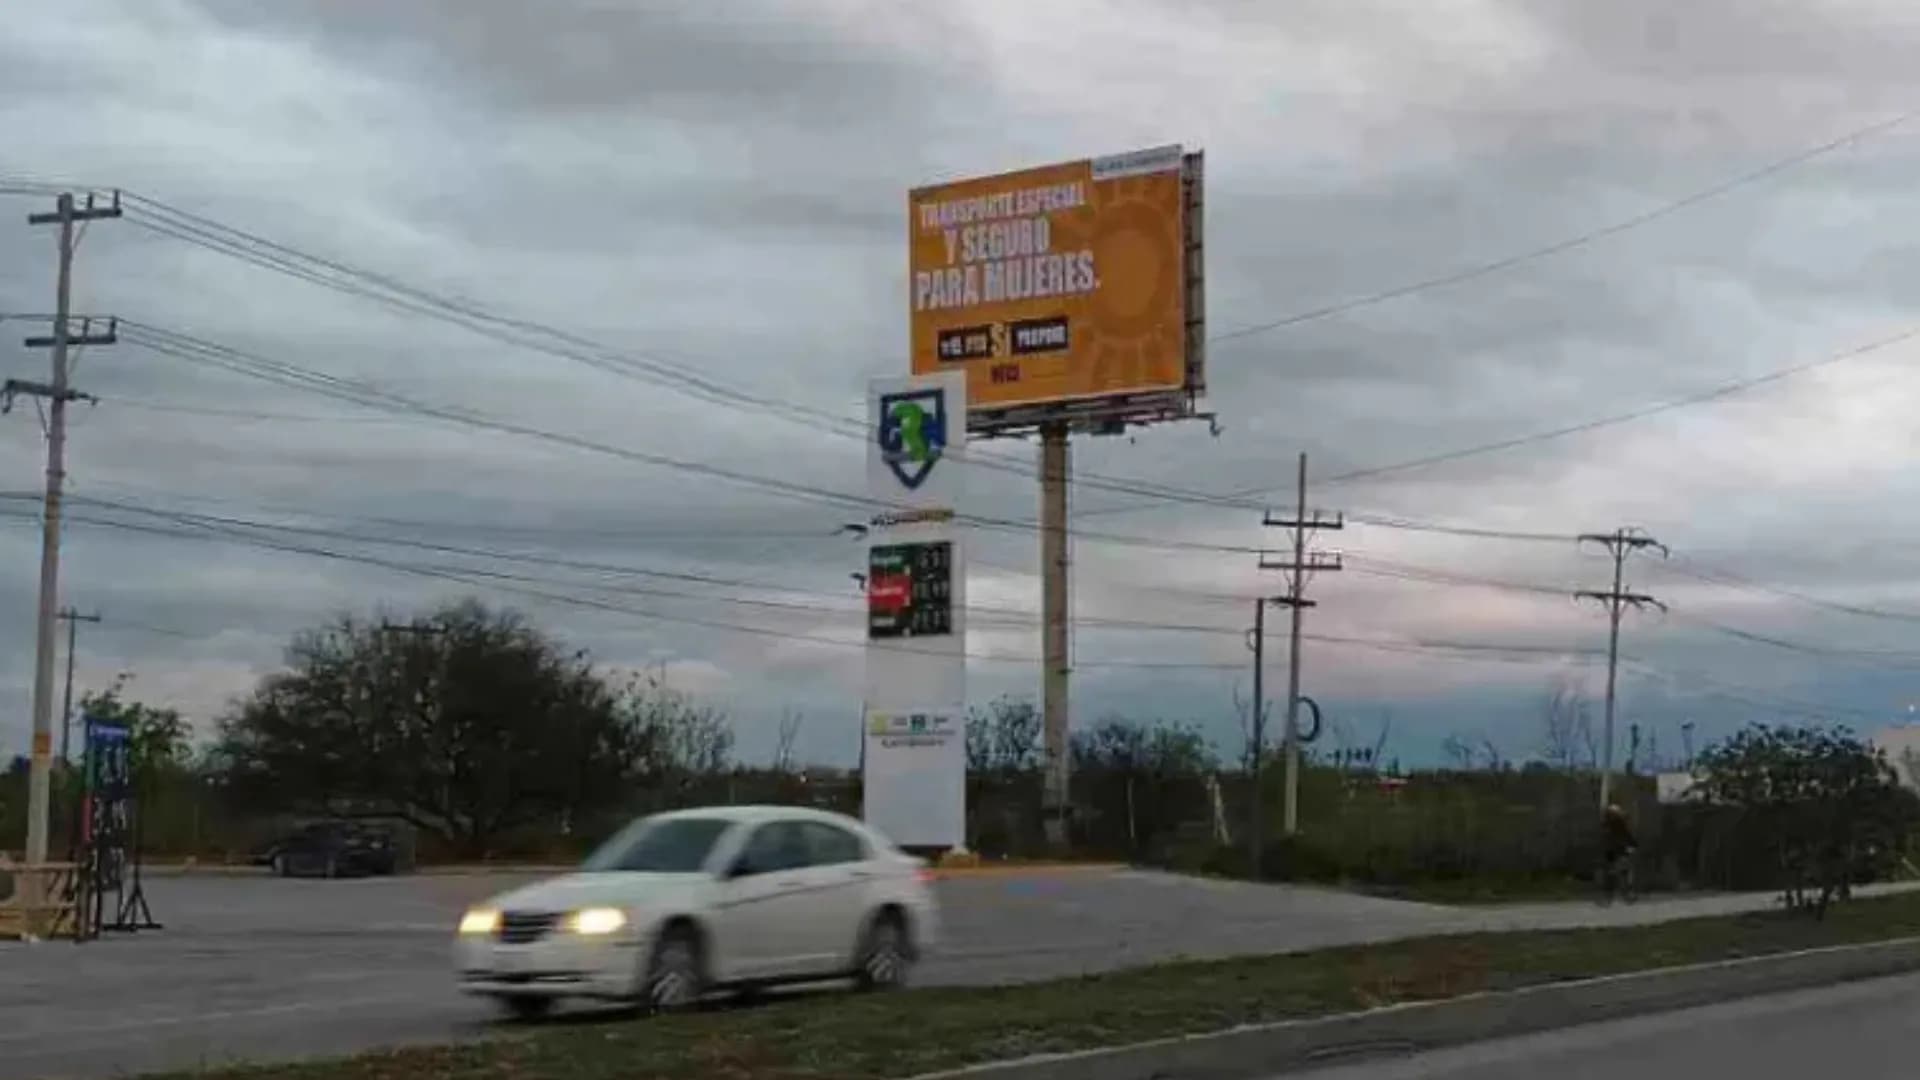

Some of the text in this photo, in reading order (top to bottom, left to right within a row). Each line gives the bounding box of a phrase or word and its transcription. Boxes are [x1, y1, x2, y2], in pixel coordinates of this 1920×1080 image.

[944, 216, 1050, 265] Y SEGURO
[916, 249, 1102, 311] PARA MUJERES.
